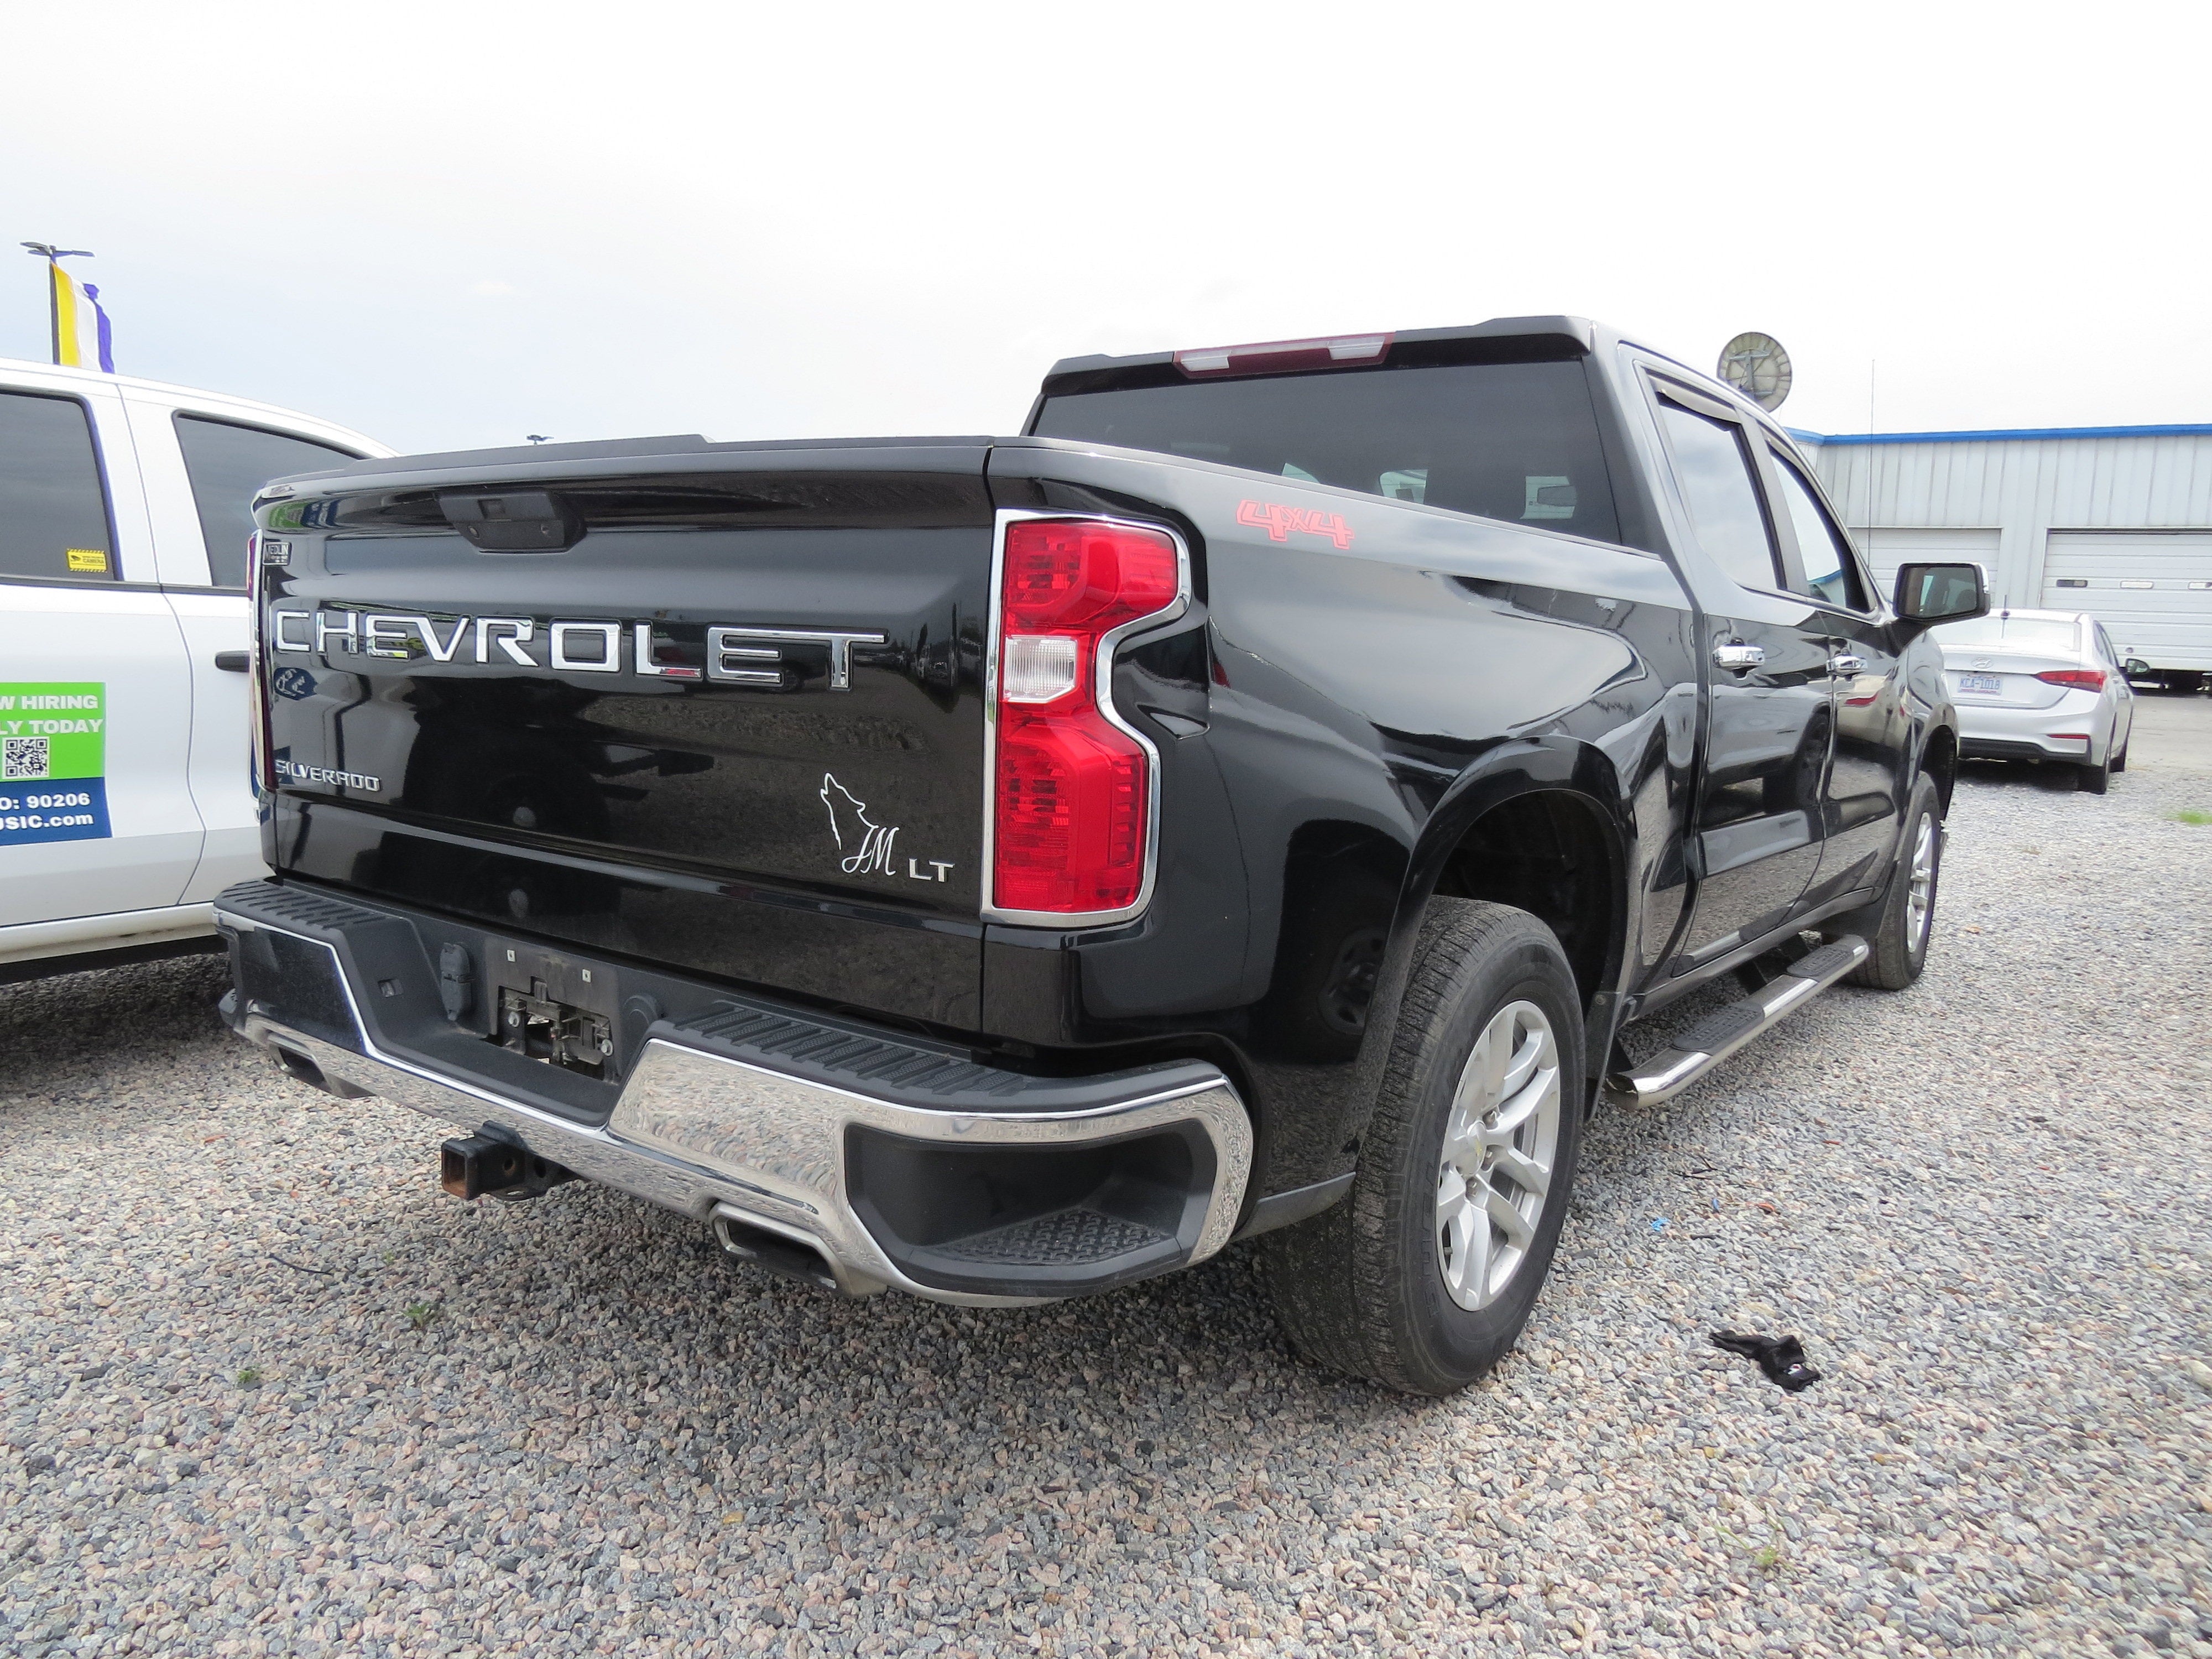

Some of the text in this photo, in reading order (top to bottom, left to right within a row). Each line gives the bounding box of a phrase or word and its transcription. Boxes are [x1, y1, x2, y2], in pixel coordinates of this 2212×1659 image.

[276, 611, 885, 689] CHEVROLET
[21, 695, 98, 709] HIRING
[29, 719, 103, 734] TODAY
[275, 760, 381, 792] SILVERADO
[27, 792, 91, 809] 90206
[0, 813, 94, 830] SIC.com
[909, 858, 956, 883] LT
